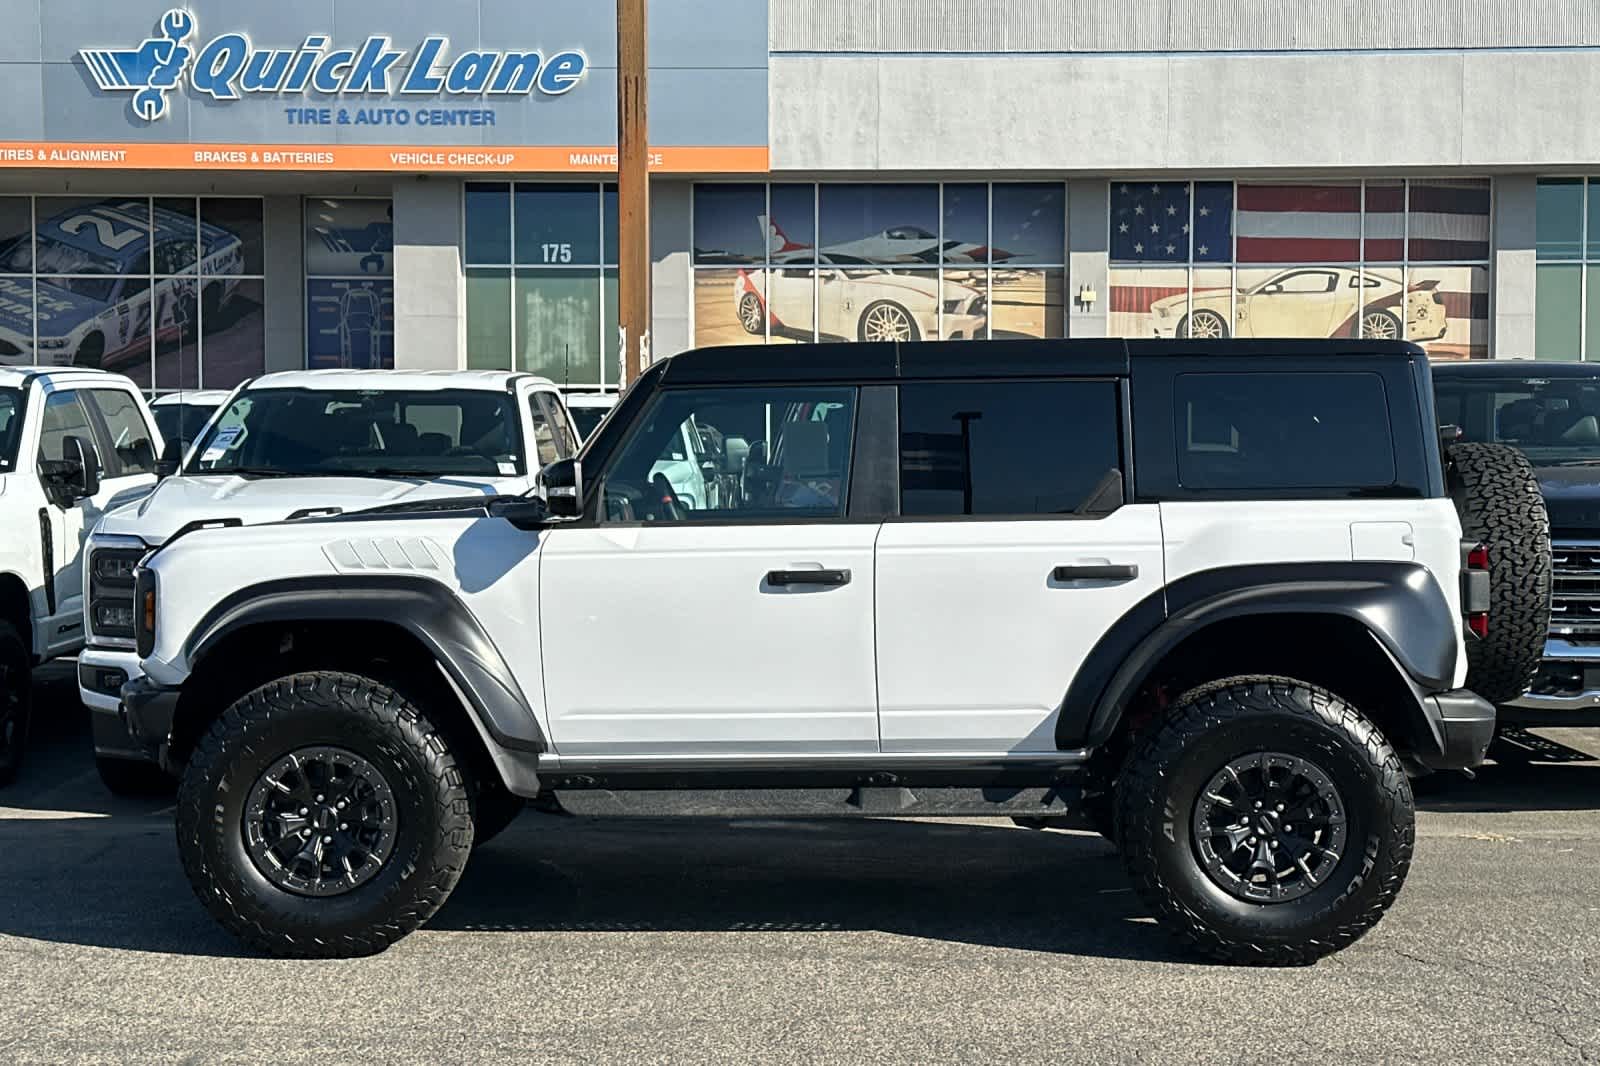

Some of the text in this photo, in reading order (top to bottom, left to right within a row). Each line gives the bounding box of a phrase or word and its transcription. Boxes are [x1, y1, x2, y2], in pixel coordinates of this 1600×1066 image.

[191, 33, 589, 99] Quick Lane
[285, 108, 496, 126] TIRE & AUTO CENTER
[37, 149, 47, 161] &
[49, 149, 127, 162] ALIGNMENT
[194, 151, 334, 164] BRAKES & BATTERIES
[389, 152, 515, 165] VEHICLE CHECK-UP
[569, 153, 663, 166] MAINTECE
[541, 243, 572, 263] 175
